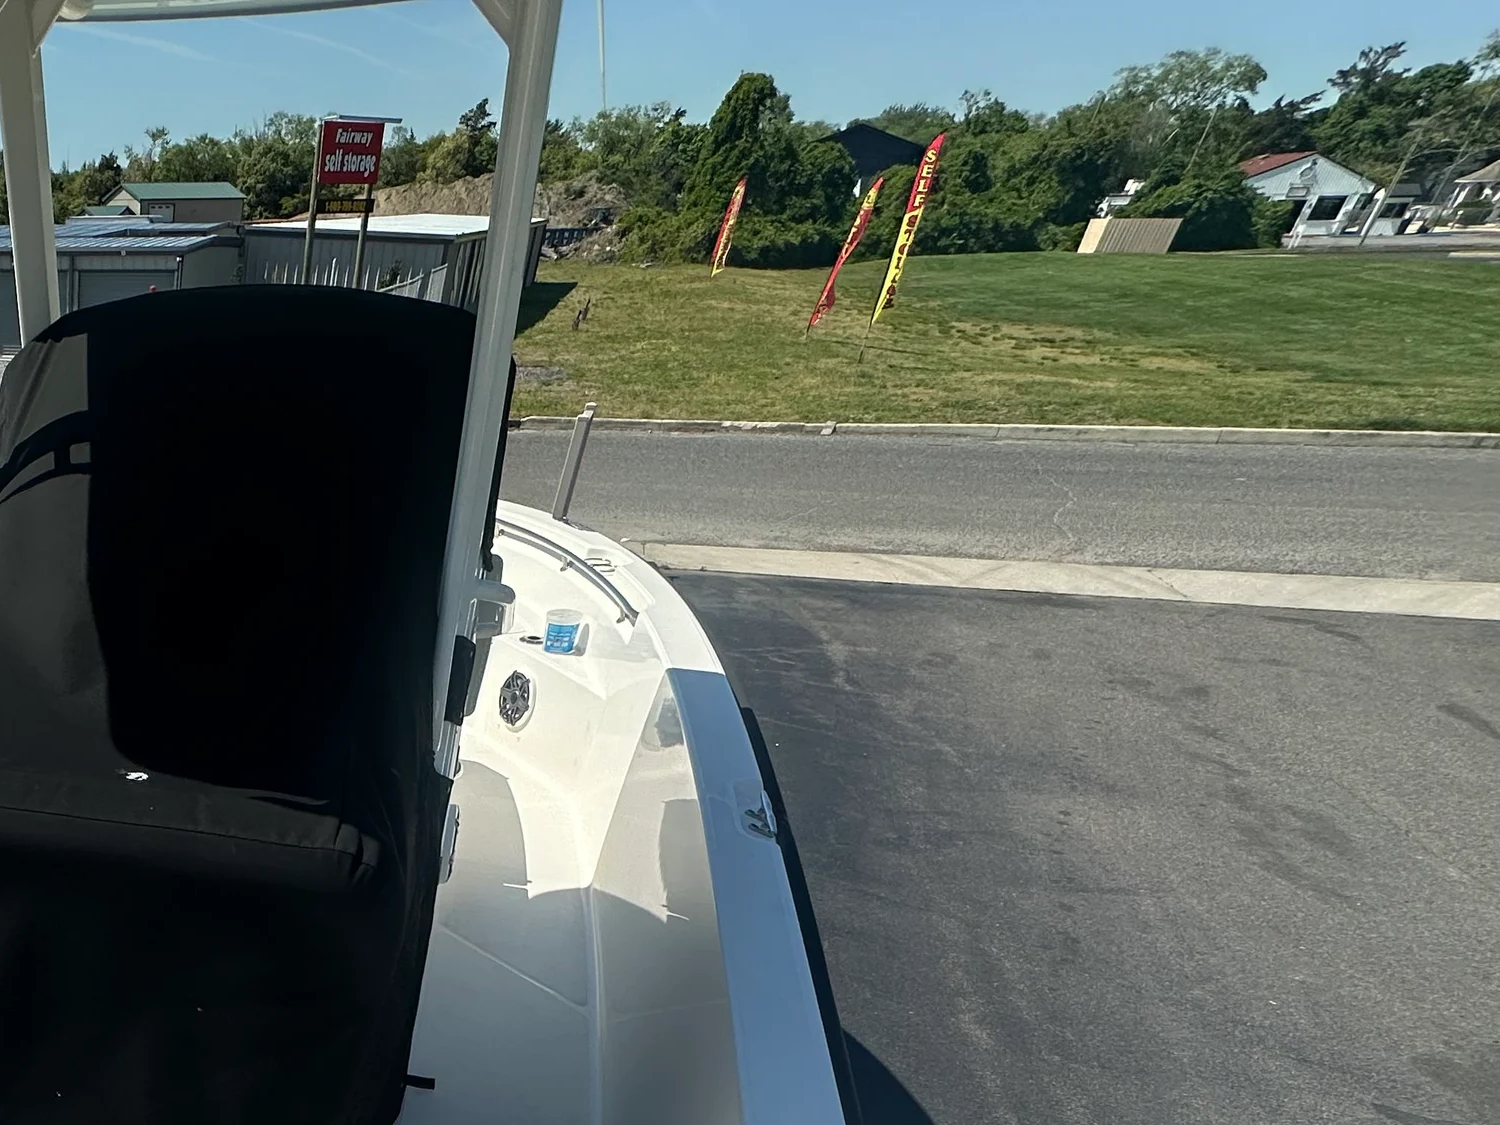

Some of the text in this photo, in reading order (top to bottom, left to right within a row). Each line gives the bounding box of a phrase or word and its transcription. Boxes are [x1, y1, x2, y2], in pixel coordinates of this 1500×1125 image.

[335, 128, 373, 147] Fairway
[324, 149, 376, 178] self storage
[913, 149, 937, 207] SELF
